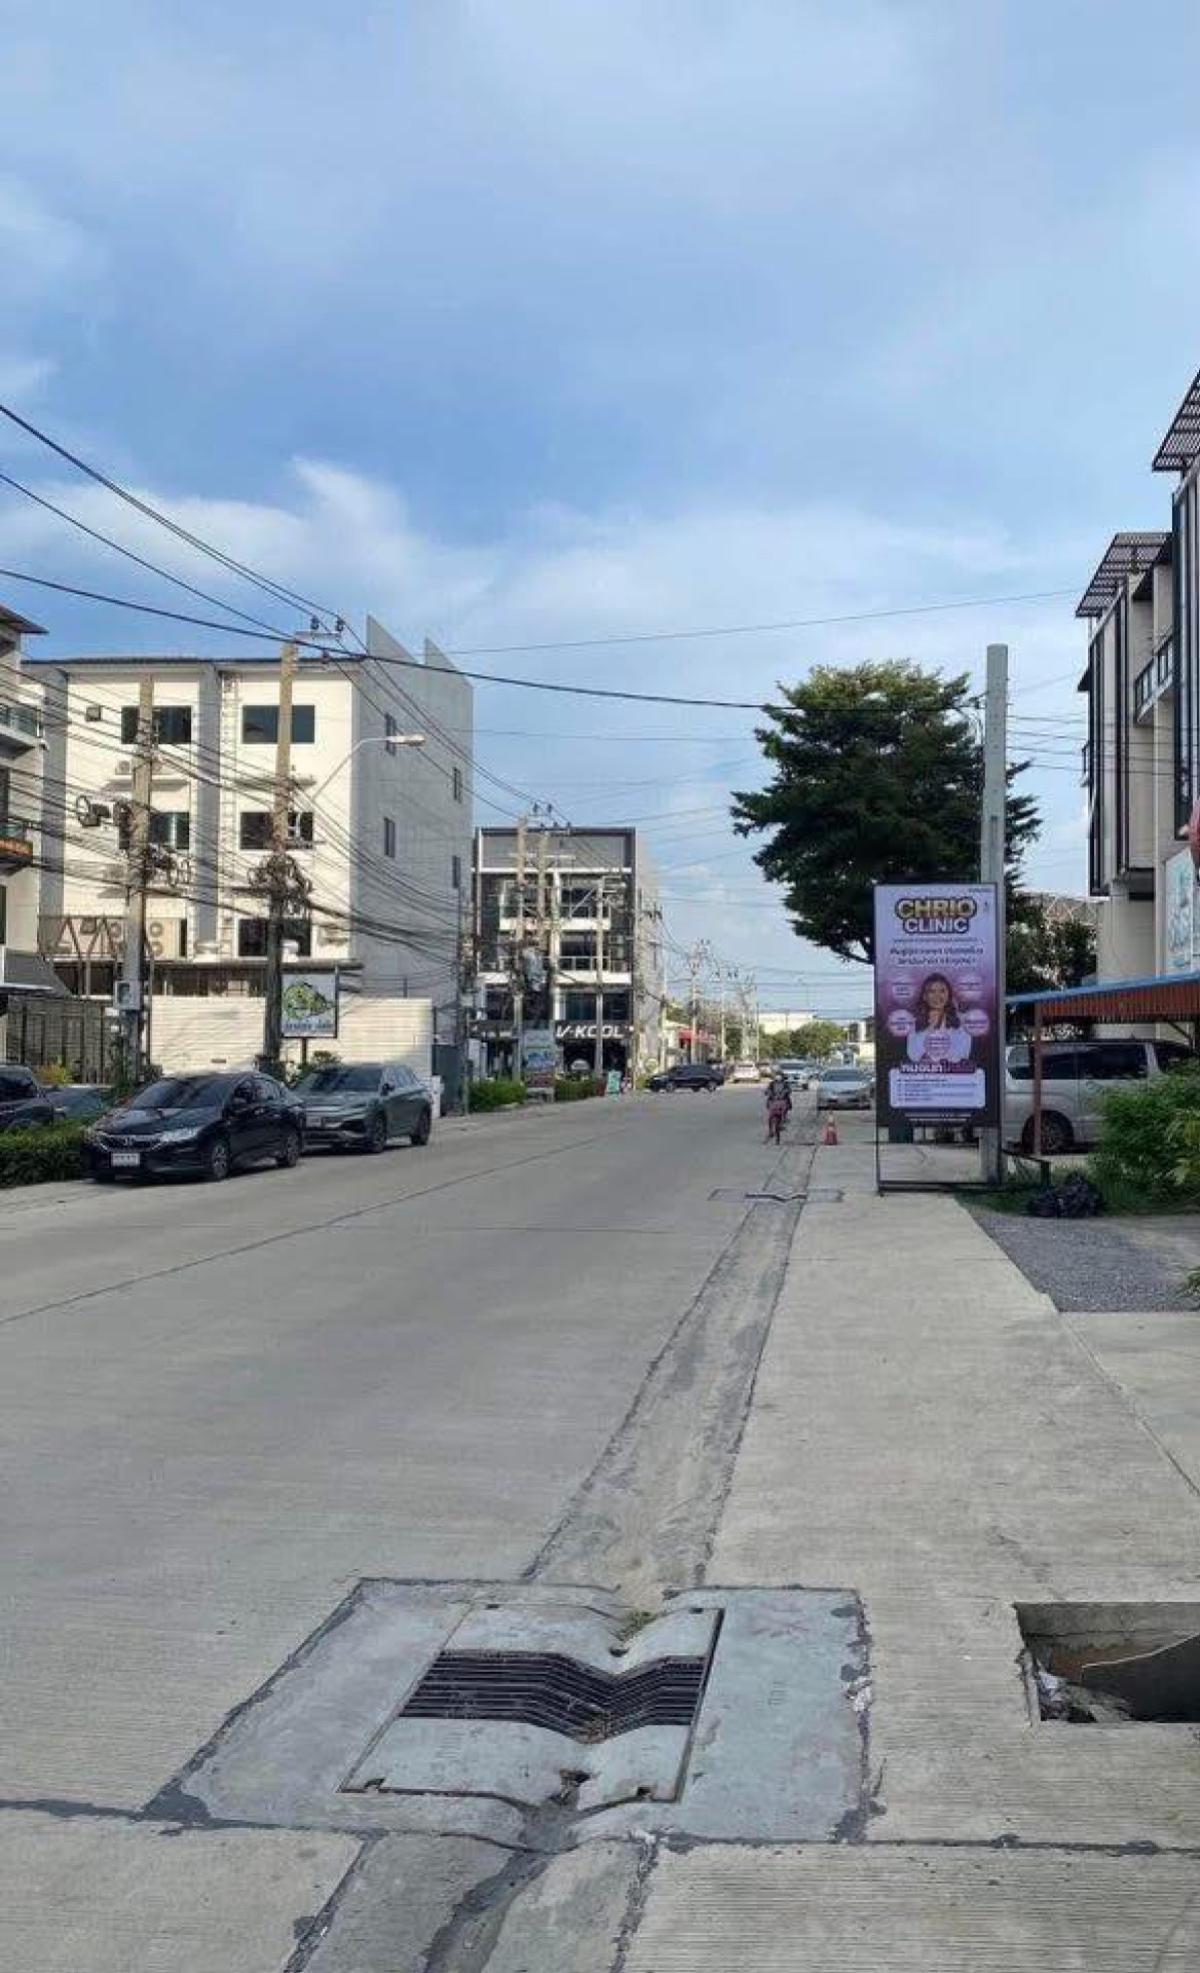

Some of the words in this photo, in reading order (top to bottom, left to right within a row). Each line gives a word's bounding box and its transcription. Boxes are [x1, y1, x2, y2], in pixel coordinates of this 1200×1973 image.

[897, 899, 976, 918] CHRIO
[904, 918, 969, 933] CLINIC
[556, 1024, 625, 1038] V-KOOL
